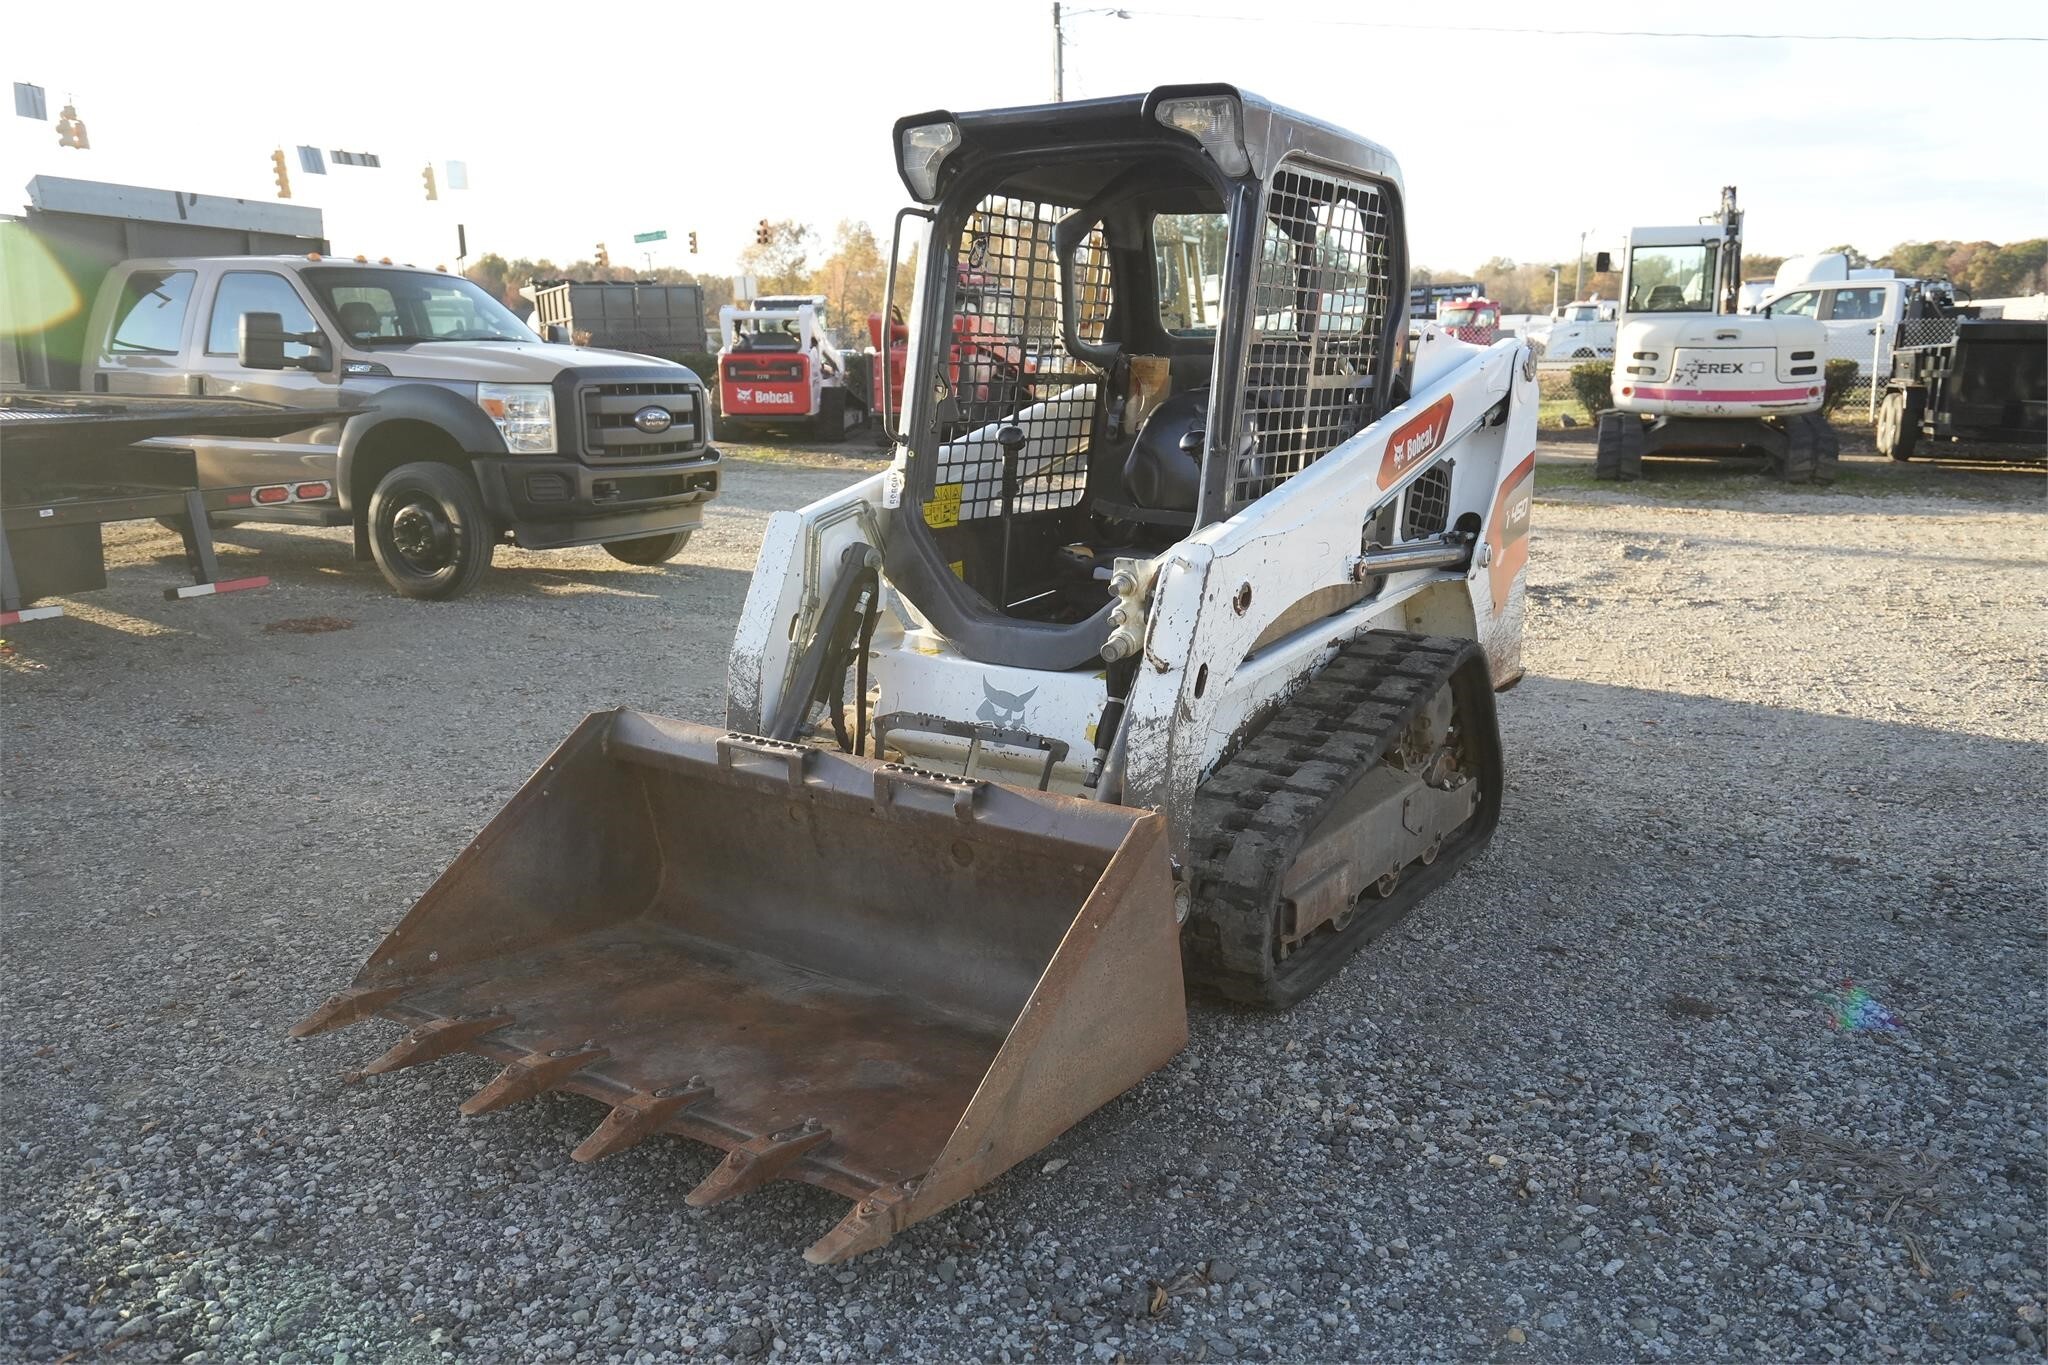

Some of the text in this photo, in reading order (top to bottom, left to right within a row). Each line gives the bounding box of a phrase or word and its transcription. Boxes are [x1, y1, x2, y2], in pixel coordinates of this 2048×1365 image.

[755, 390, 794, 404] Bobcat
[1407, 424, 1433, 461] Bobcat
[1506, 496, 1529, 529] T450
